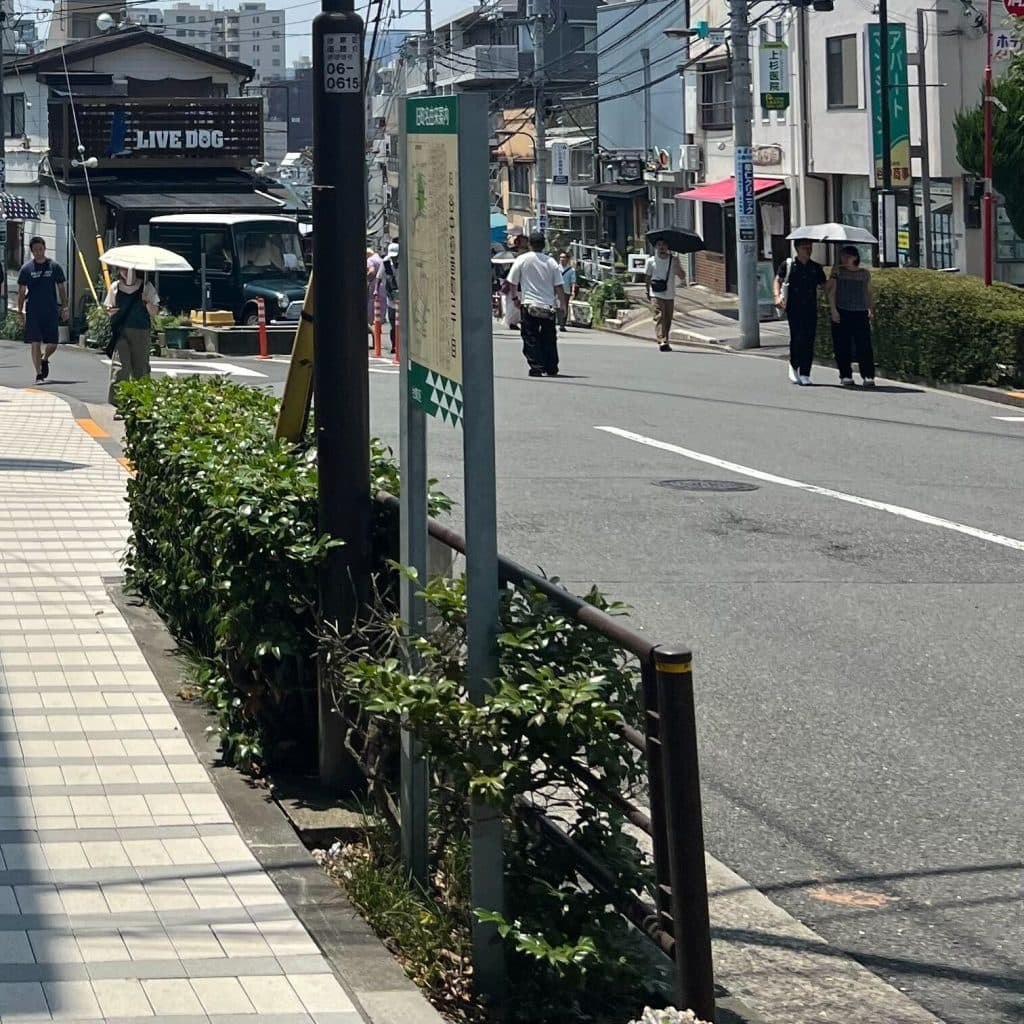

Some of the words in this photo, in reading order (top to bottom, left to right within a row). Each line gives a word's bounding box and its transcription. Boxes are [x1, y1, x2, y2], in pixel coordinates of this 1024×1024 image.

[996, 34, 1023, 49] ホテ
[327, 63, 354, 75] 06-
[769, 51, 780, 91] 上杉医院
[888, 31, 902, 118] アパート
[327, 77, 359, 89] 0615
[137, 130, 182, 149] LIVE
[186, 129, 224, 148] DOG
